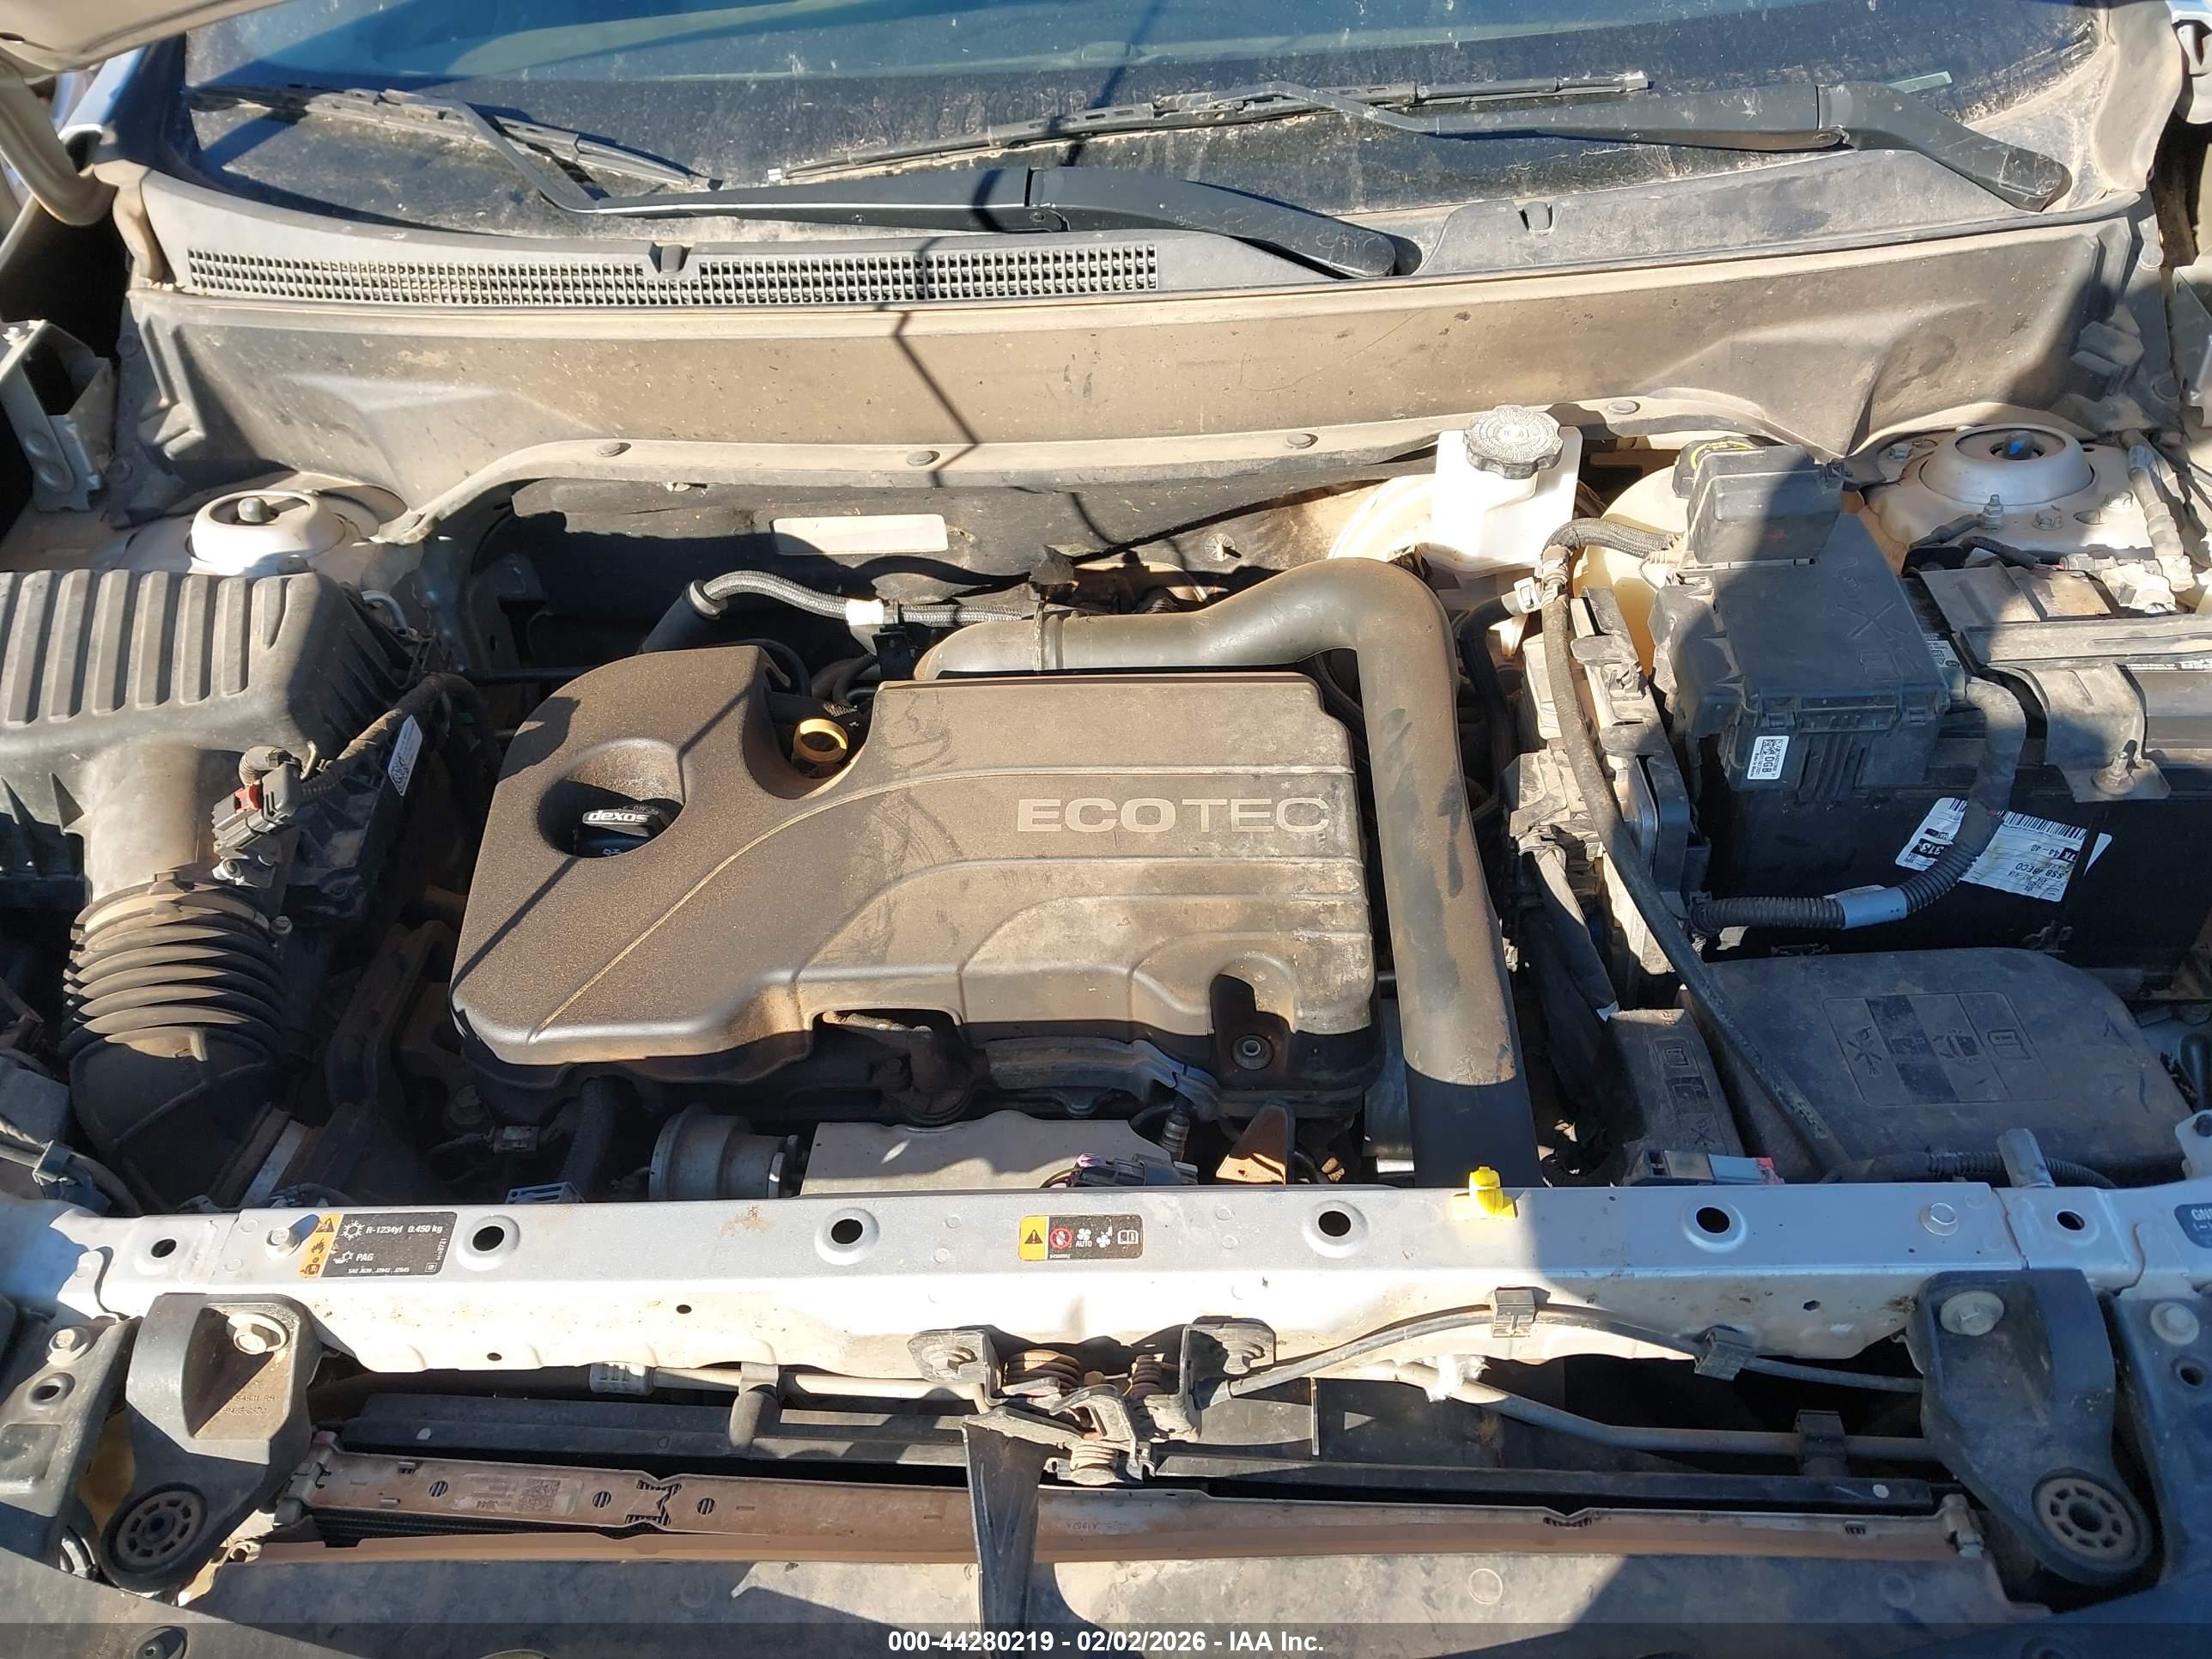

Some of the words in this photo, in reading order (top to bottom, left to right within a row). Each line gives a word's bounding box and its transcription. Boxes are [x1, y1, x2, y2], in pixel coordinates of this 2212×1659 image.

[1762, 757, 1775, 773] DGB
[587, 810, 650, 823] dexos
[1017, 797, 1330, 833] ECOTEC
[2045, 869, 2065, 879] SSB
[366, 1225, 404, 1235] R-1234yf
[432, 1224, 443, 1234] kg
[356, 1253, 374, 1261] PAG
